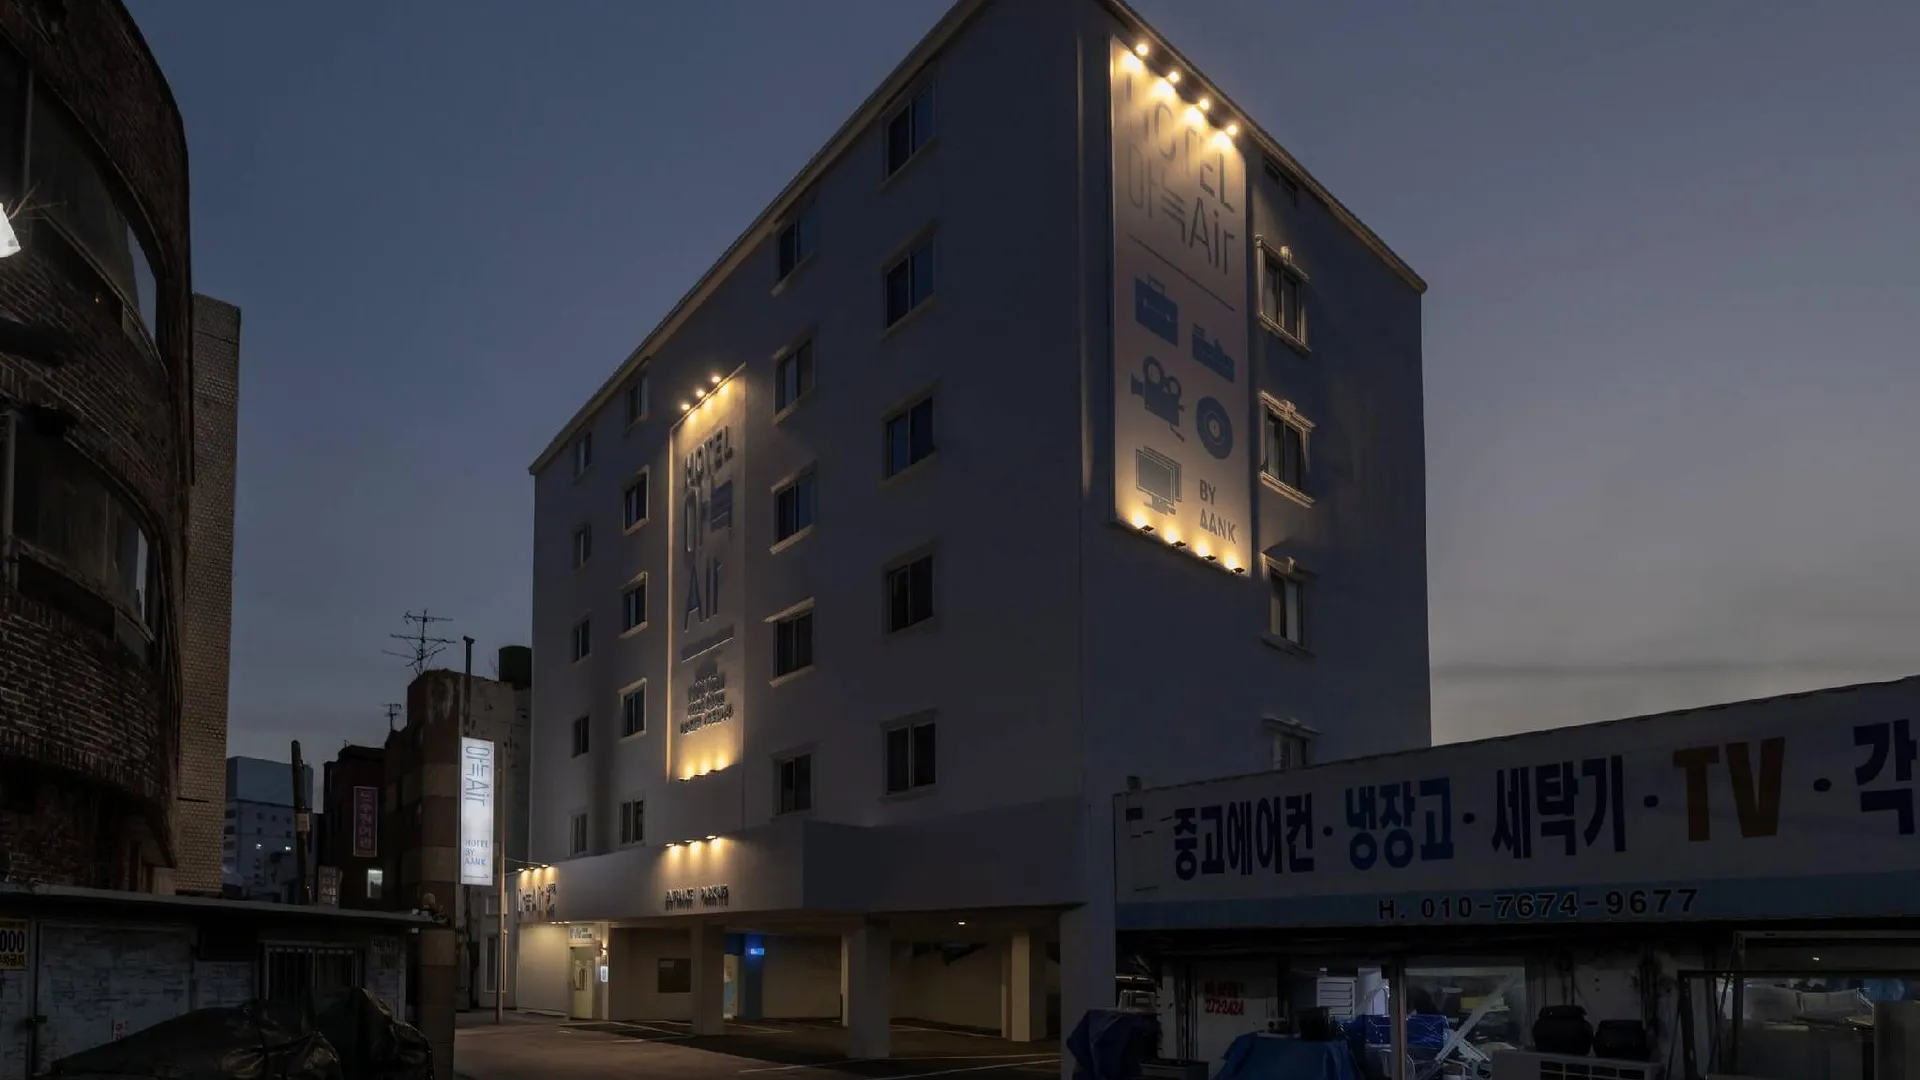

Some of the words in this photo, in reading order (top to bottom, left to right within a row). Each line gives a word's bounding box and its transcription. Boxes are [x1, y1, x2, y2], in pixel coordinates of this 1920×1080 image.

[684, 425, 733, 488] HOTEL
[1200, 480, 1216, 505] BY
[684, 556, 724, 633] Air
[1174, 793, 1314, 881] 중고에어컨
[1345, 777, 1454, 870] 냉장고
[1491, 755, 1626, 859] 세탁기
[1673, 736, 1785, 841] TV
[1854, 719, 1918, 835] 각
[465, 839, 489, 848] HOTEL
[465, 848, 475, 856] BY
[1378, 898, 1405, 920] H.
[1421, 888, 1698, 919] 010-7674-9677
